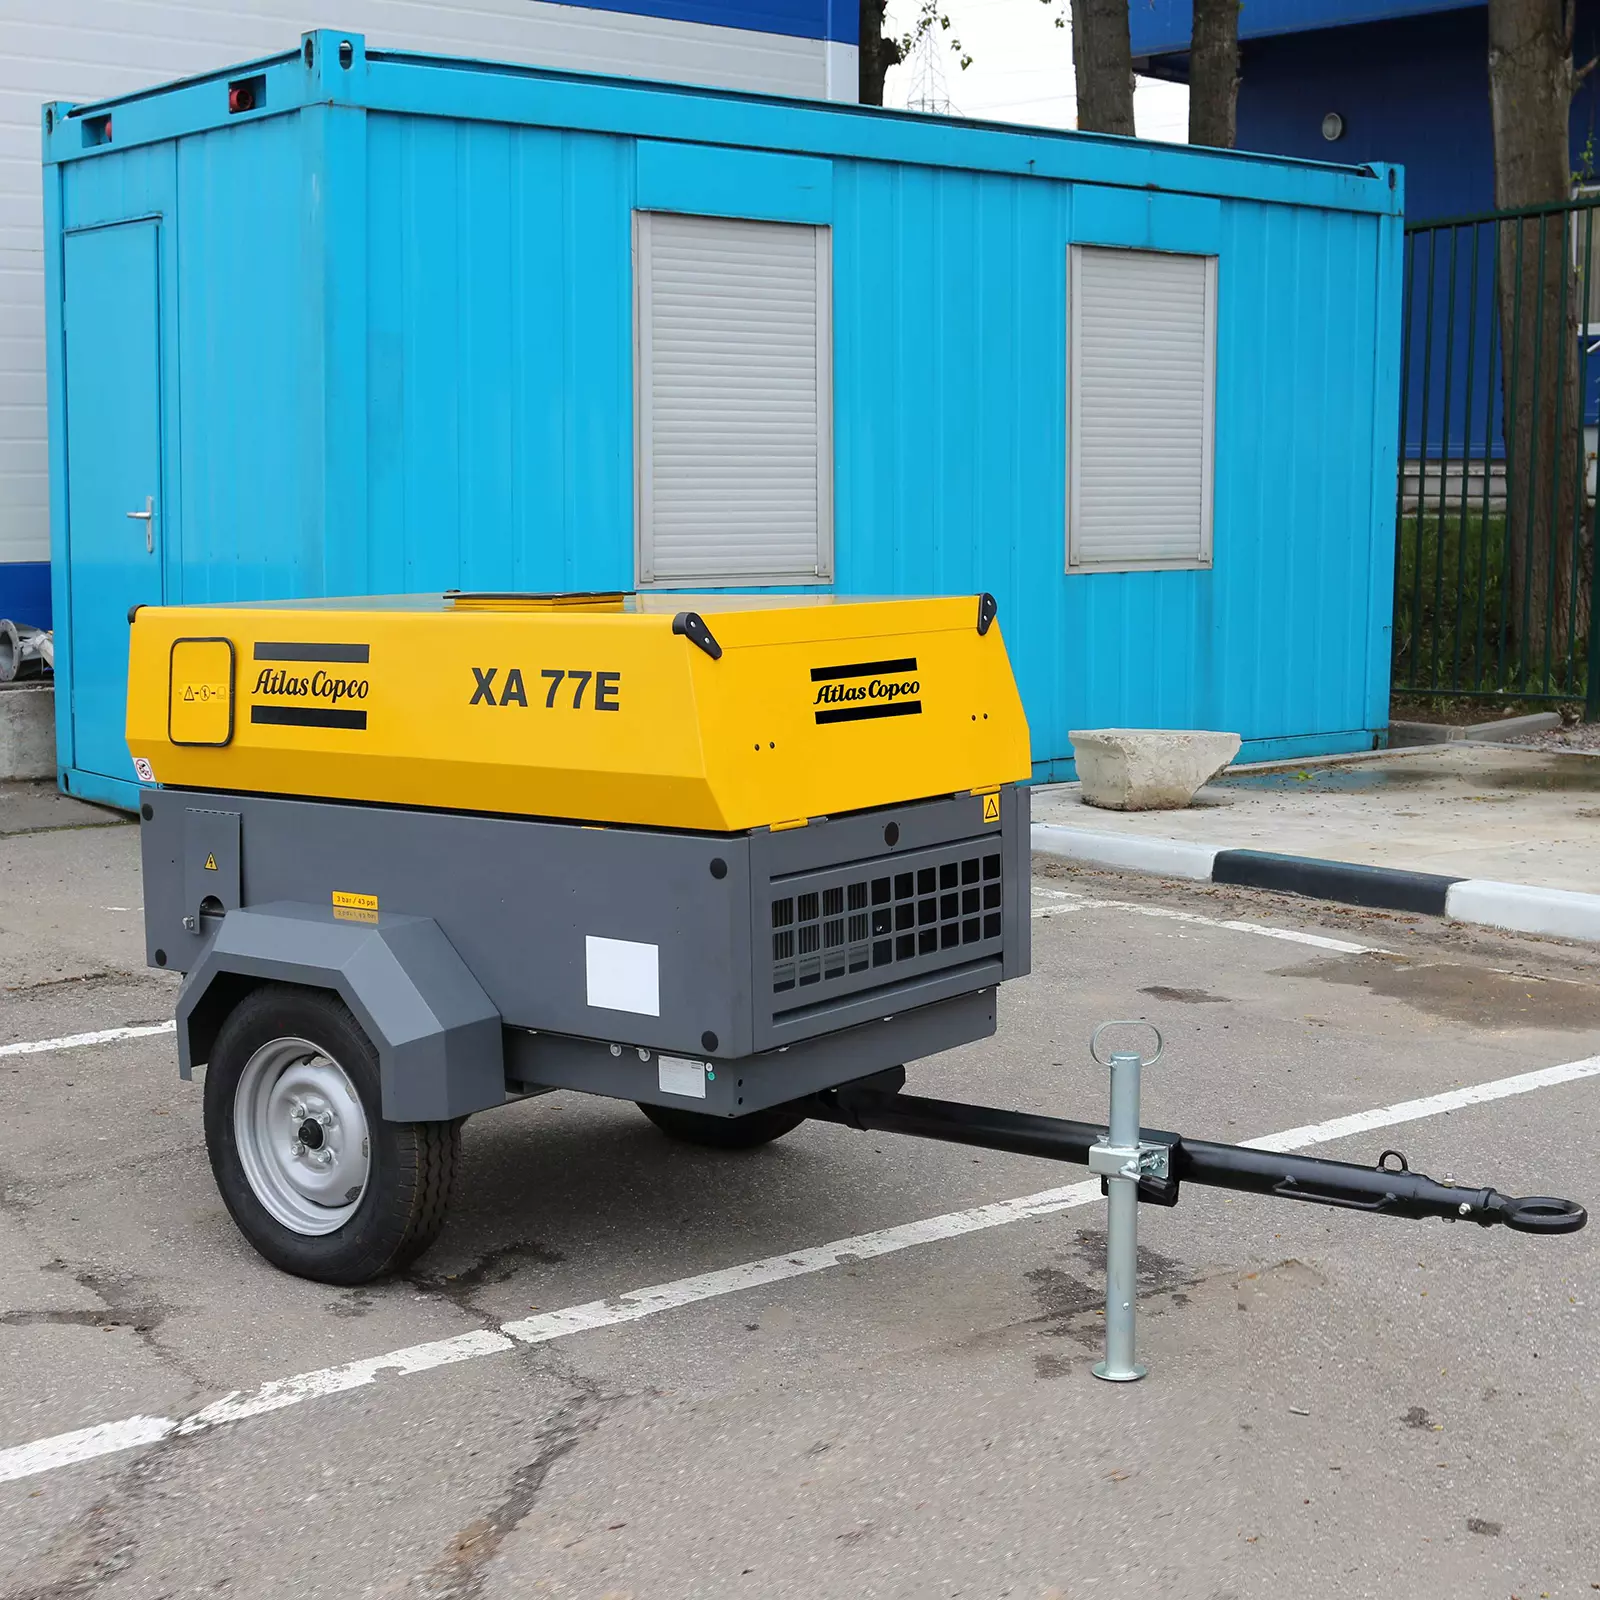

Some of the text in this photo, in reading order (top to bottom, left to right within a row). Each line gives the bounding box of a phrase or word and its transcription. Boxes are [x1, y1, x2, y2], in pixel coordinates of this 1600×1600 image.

[251, 668, 369, 703] Atlas Copco
[469, 667, 621, 711] XA 77E
[813, 679, 920, 705] Atlas Copco
[366, 899, 376, 907] psi
